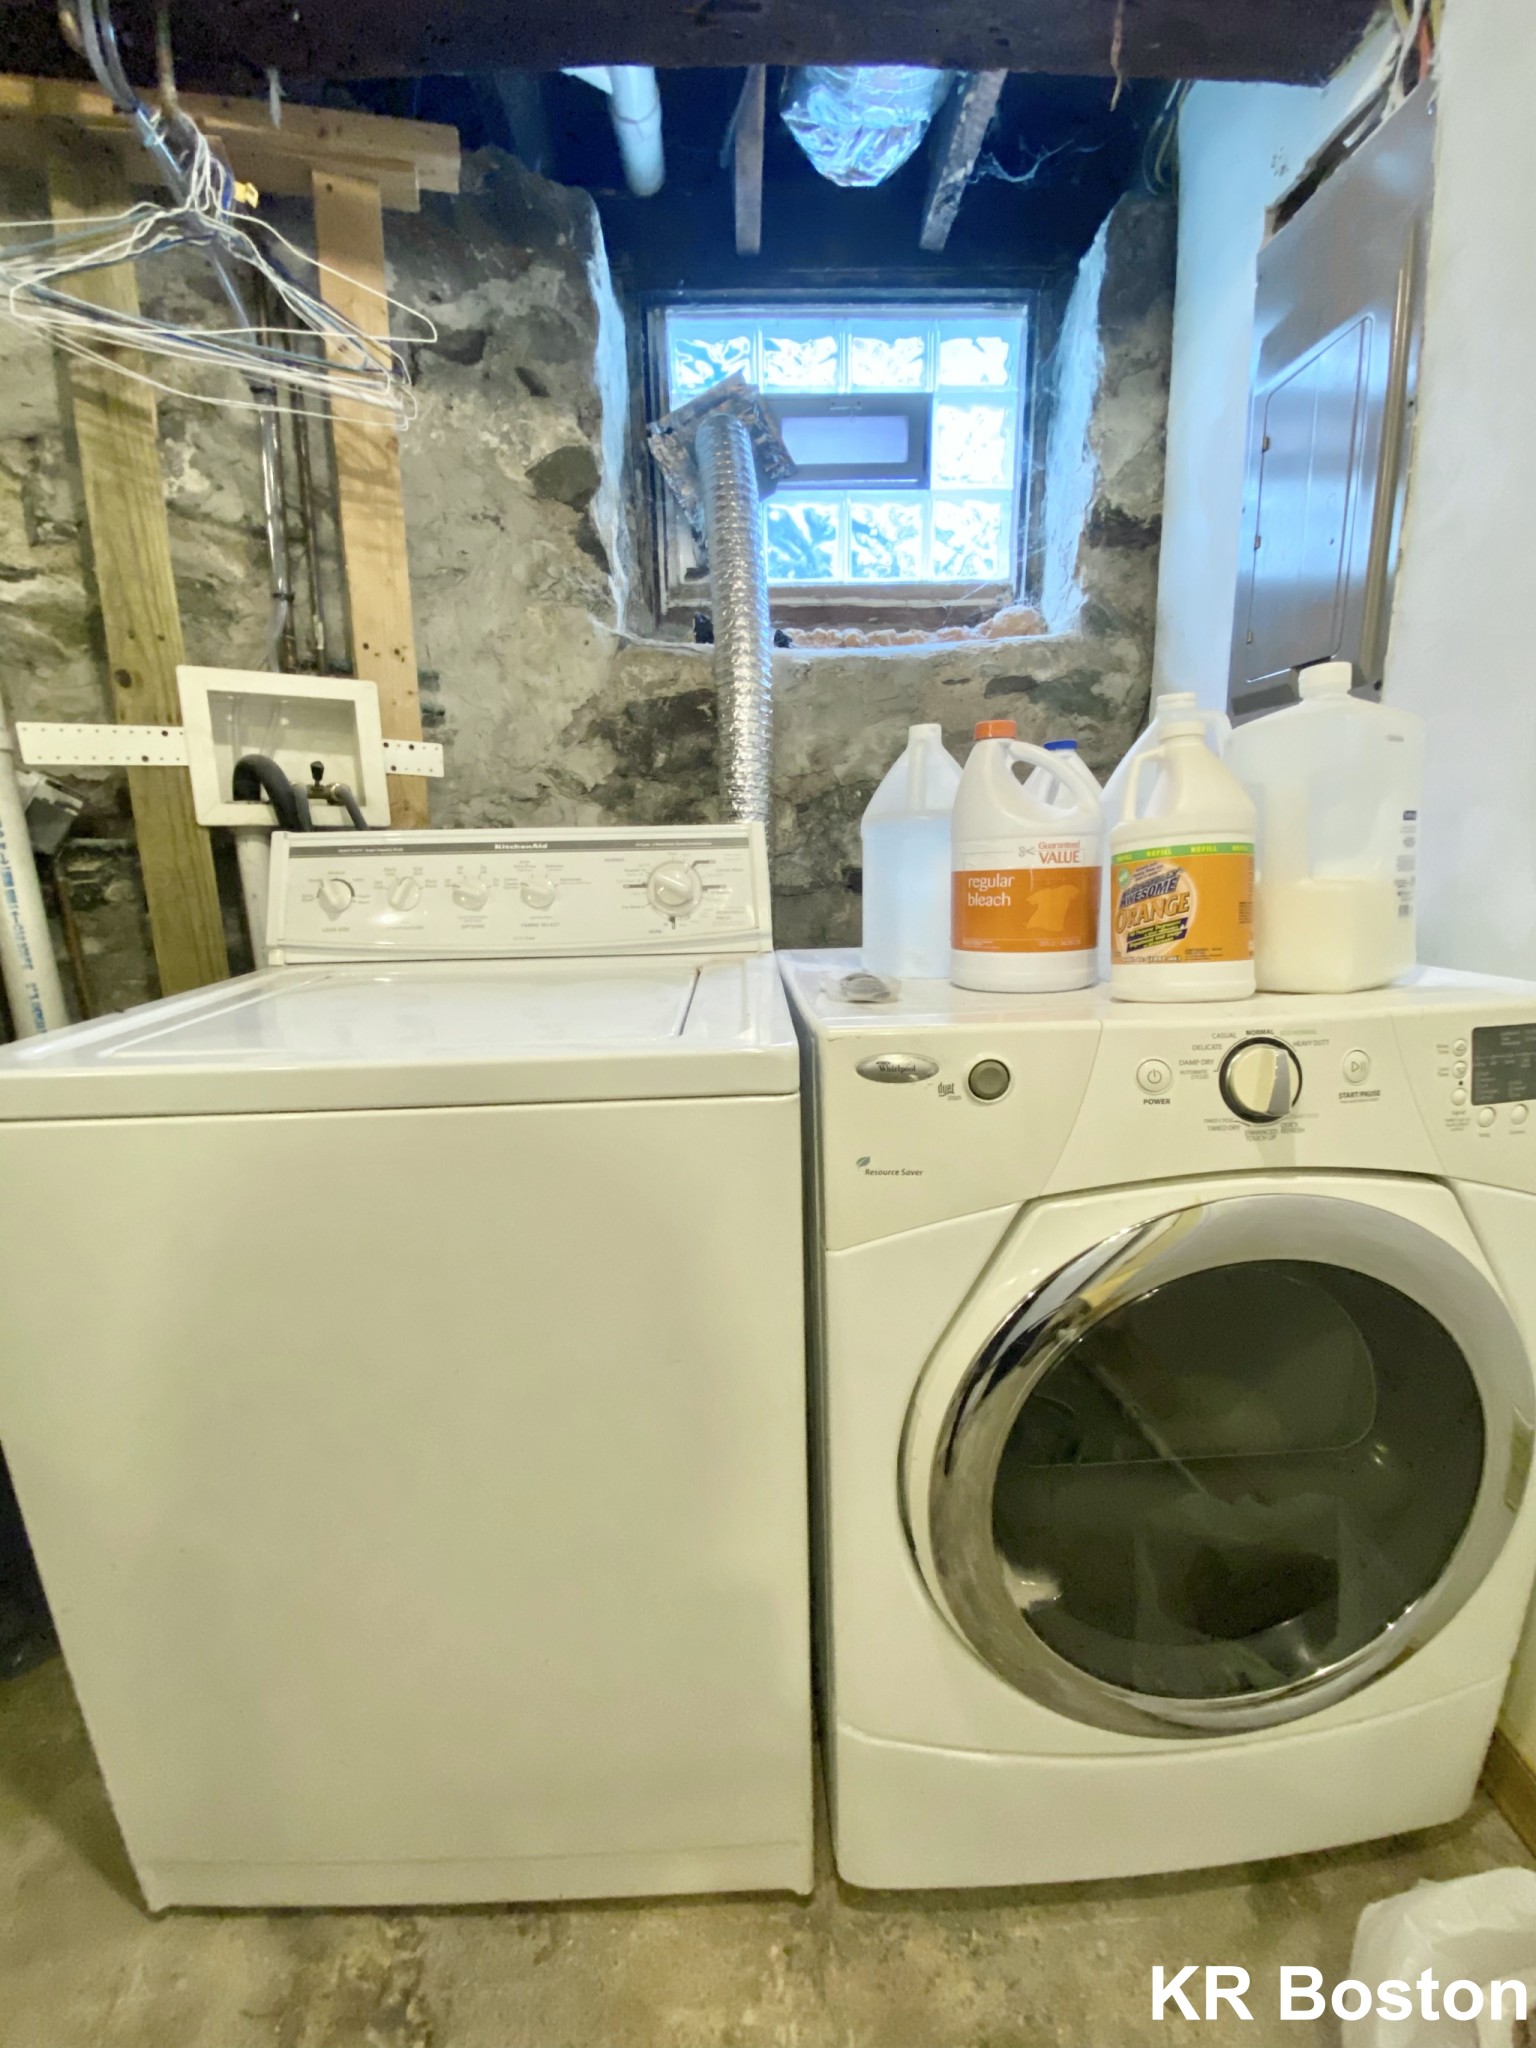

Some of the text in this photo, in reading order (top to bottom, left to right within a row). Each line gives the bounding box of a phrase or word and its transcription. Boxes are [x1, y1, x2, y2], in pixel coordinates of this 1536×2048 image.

[494, 842, 548, 850] KitchenAid
[1191, 845, 1217, 853] REFILL
[1039, 850, 1081, 864] VALUE
[968, 873, 1015, 891] regular
[1119, 877, 1179, 909] AWESOME
[968, 892, 1011, 907] bleach
[1115, 891, 1190, 934] ORANGE
[1192, 1043, 1223, 1051] DELICATE
[878, 1065, 917, 1074] Whirlpool
[865, 1168, 923, 1176] Resource Saver
